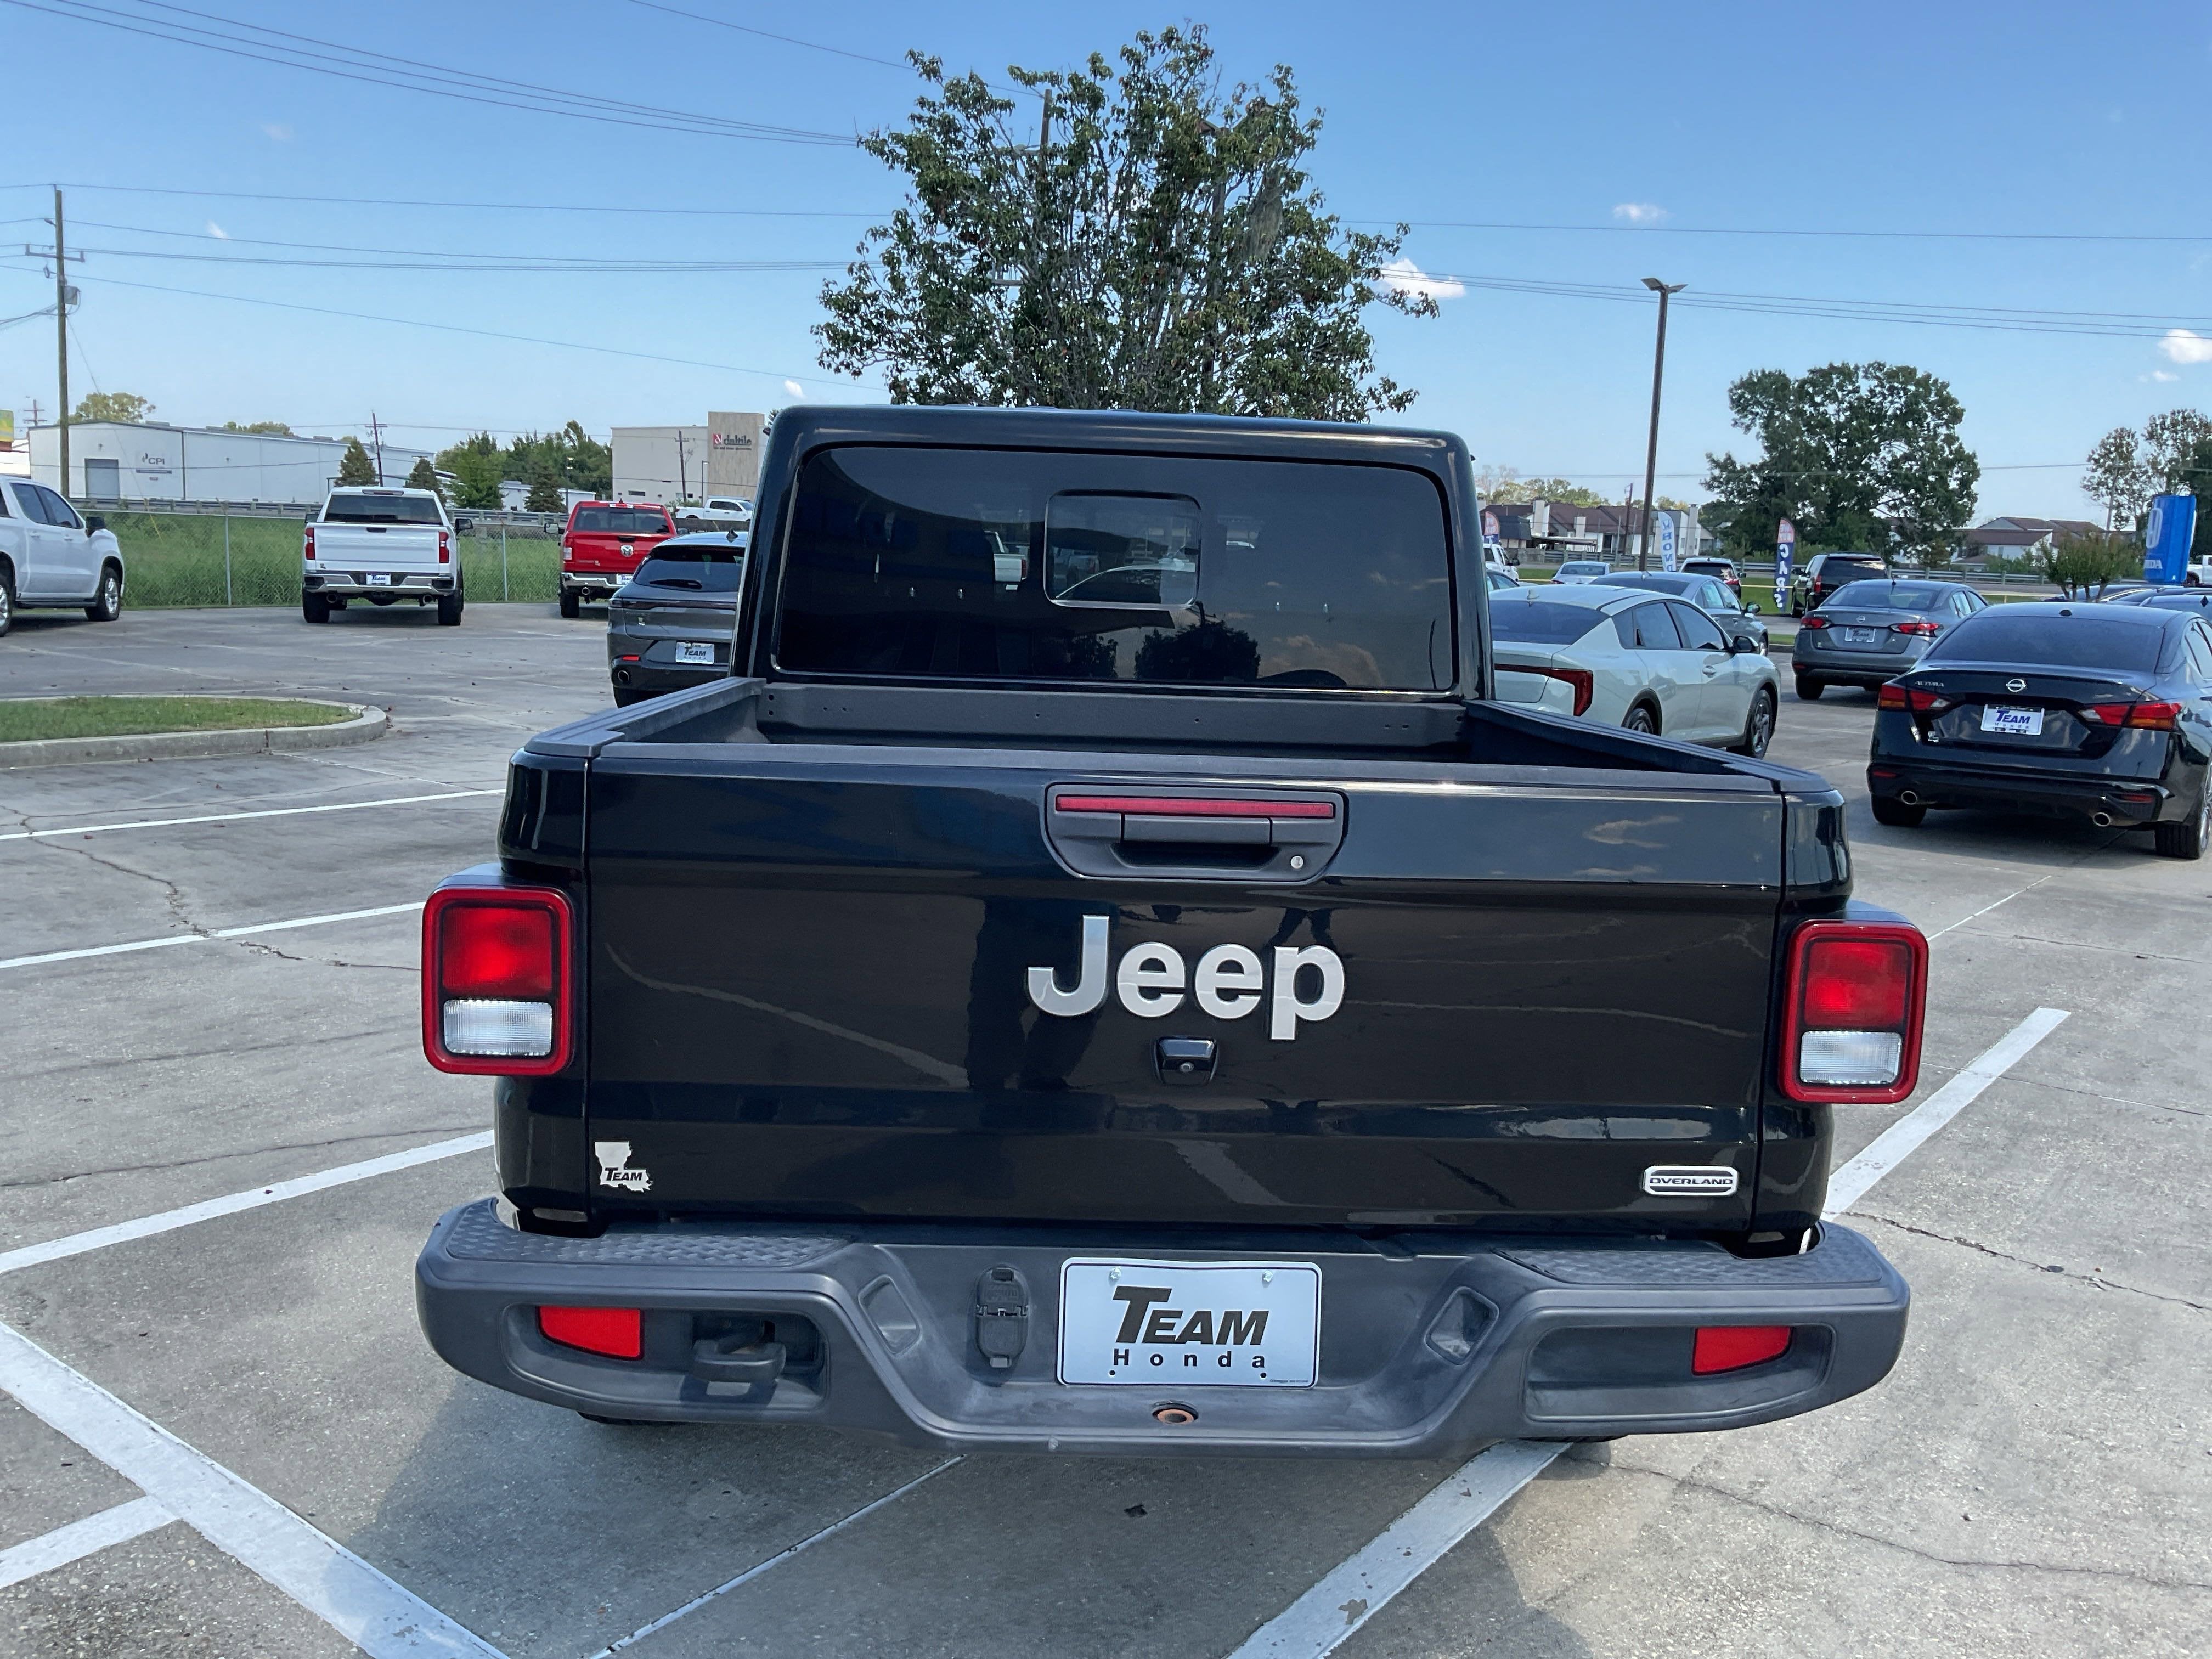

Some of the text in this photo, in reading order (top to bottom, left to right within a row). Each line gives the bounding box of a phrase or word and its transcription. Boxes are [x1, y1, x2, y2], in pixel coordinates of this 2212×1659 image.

[684, 647, 706, 656] TEAM
[1996, 710, 2031, 724] TEAM
[1028, 915, 1345, 1041] Jeep
[605, 1167, 642, 1181] TEAM
[1113, 1285, 1269, 1345] TEAM
[1113, 1348, 1265, 1368] Honda
